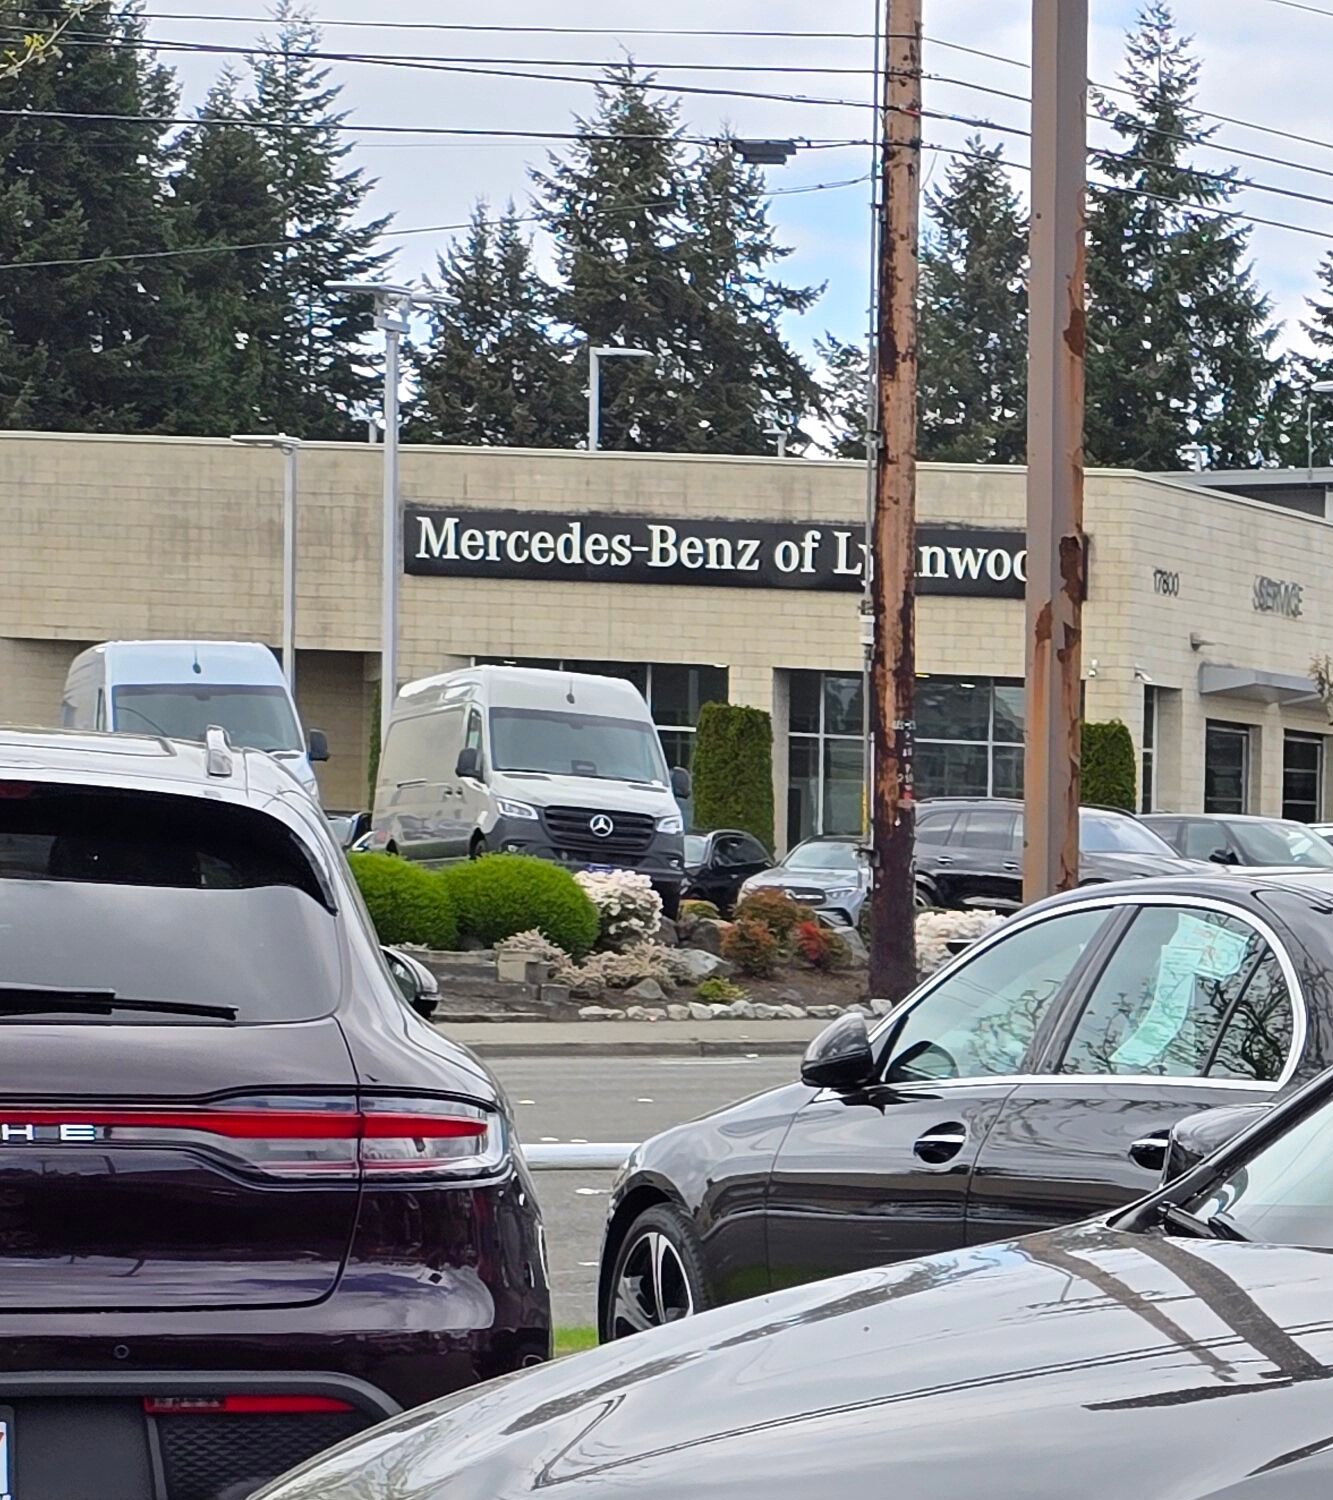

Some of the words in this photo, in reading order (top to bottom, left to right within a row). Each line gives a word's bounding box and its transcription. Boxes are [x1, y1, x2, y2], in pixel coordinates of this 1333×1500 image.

[415, 516, 760, 571] Mercedes-Benz
[774, 531, 821, 574] of
[1153, 569, 1179, 597] 17800
